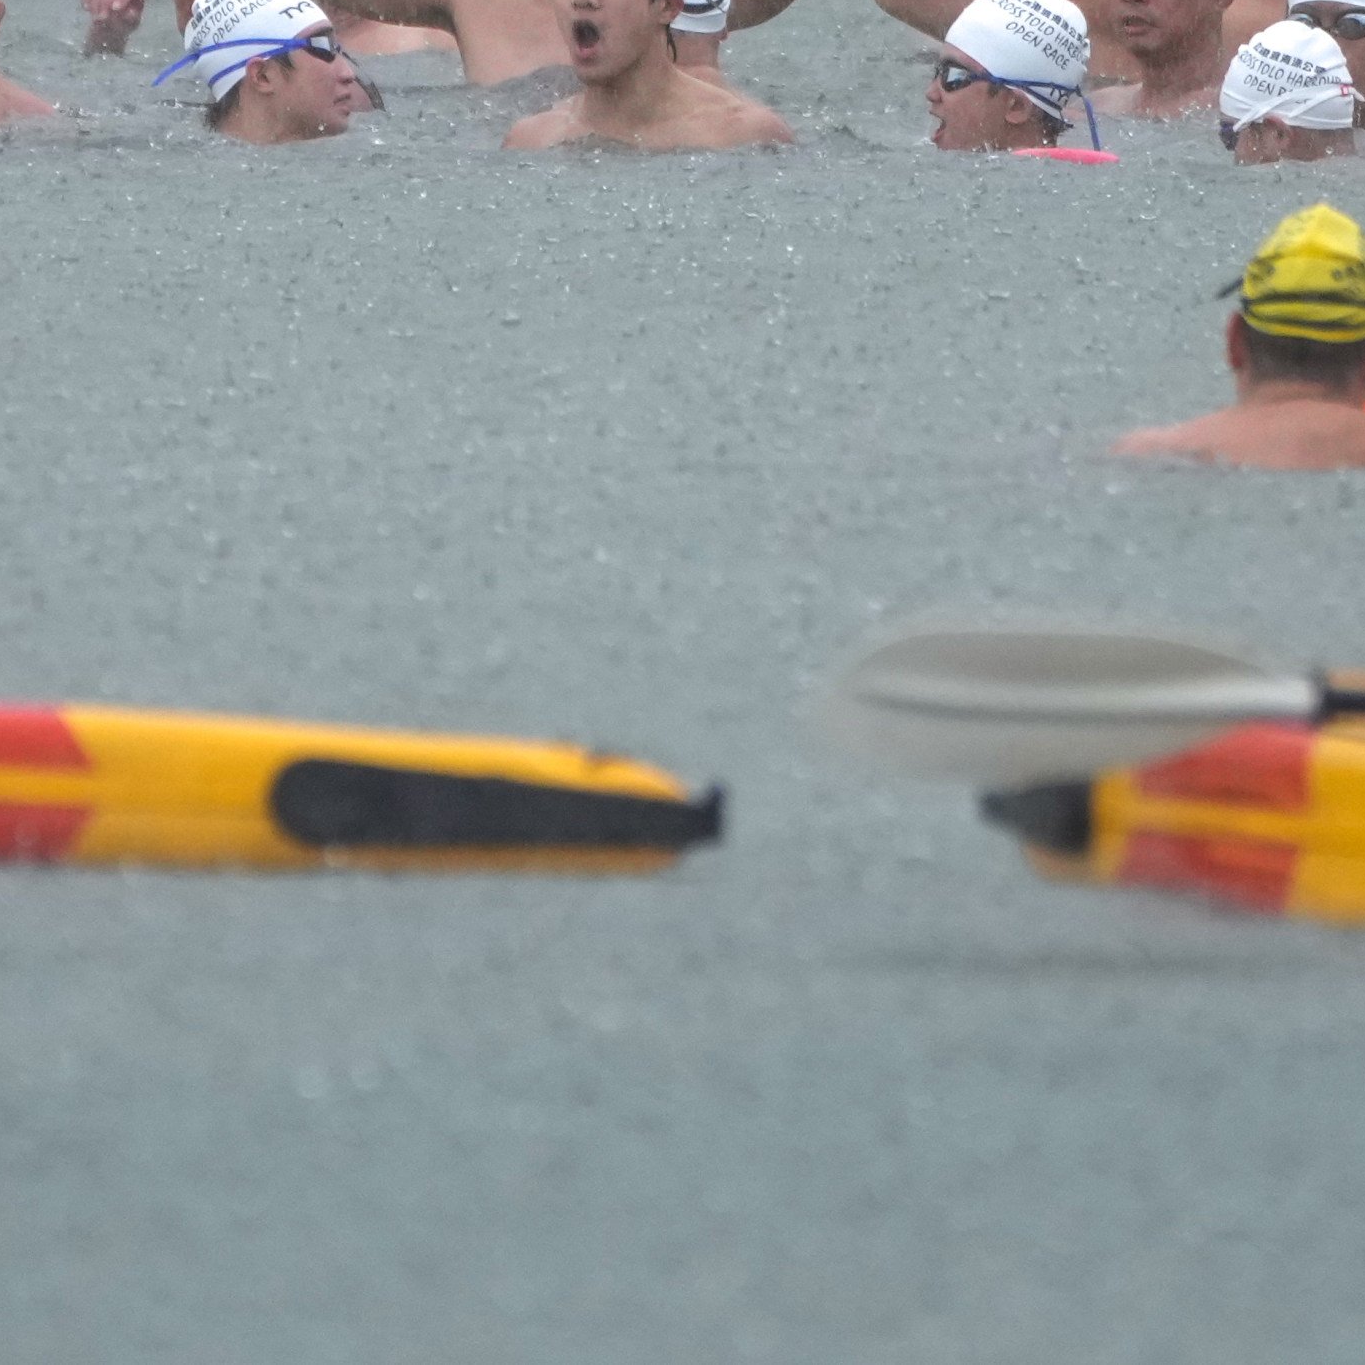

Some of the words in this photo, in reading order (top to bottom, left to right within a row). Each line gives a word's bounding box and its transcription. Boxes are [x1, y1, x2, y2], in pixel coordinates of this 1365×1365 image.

[278, 0, 315, 19] TYR
[212, 13, 241, 44] OPEN
[1024, 12, 1055, 36] TOLO
[1005, 21, 1043, 48] OPEN
[1043, 44, 1071, 71] RACE
[1243, 73, 1275, 96] OPEN
